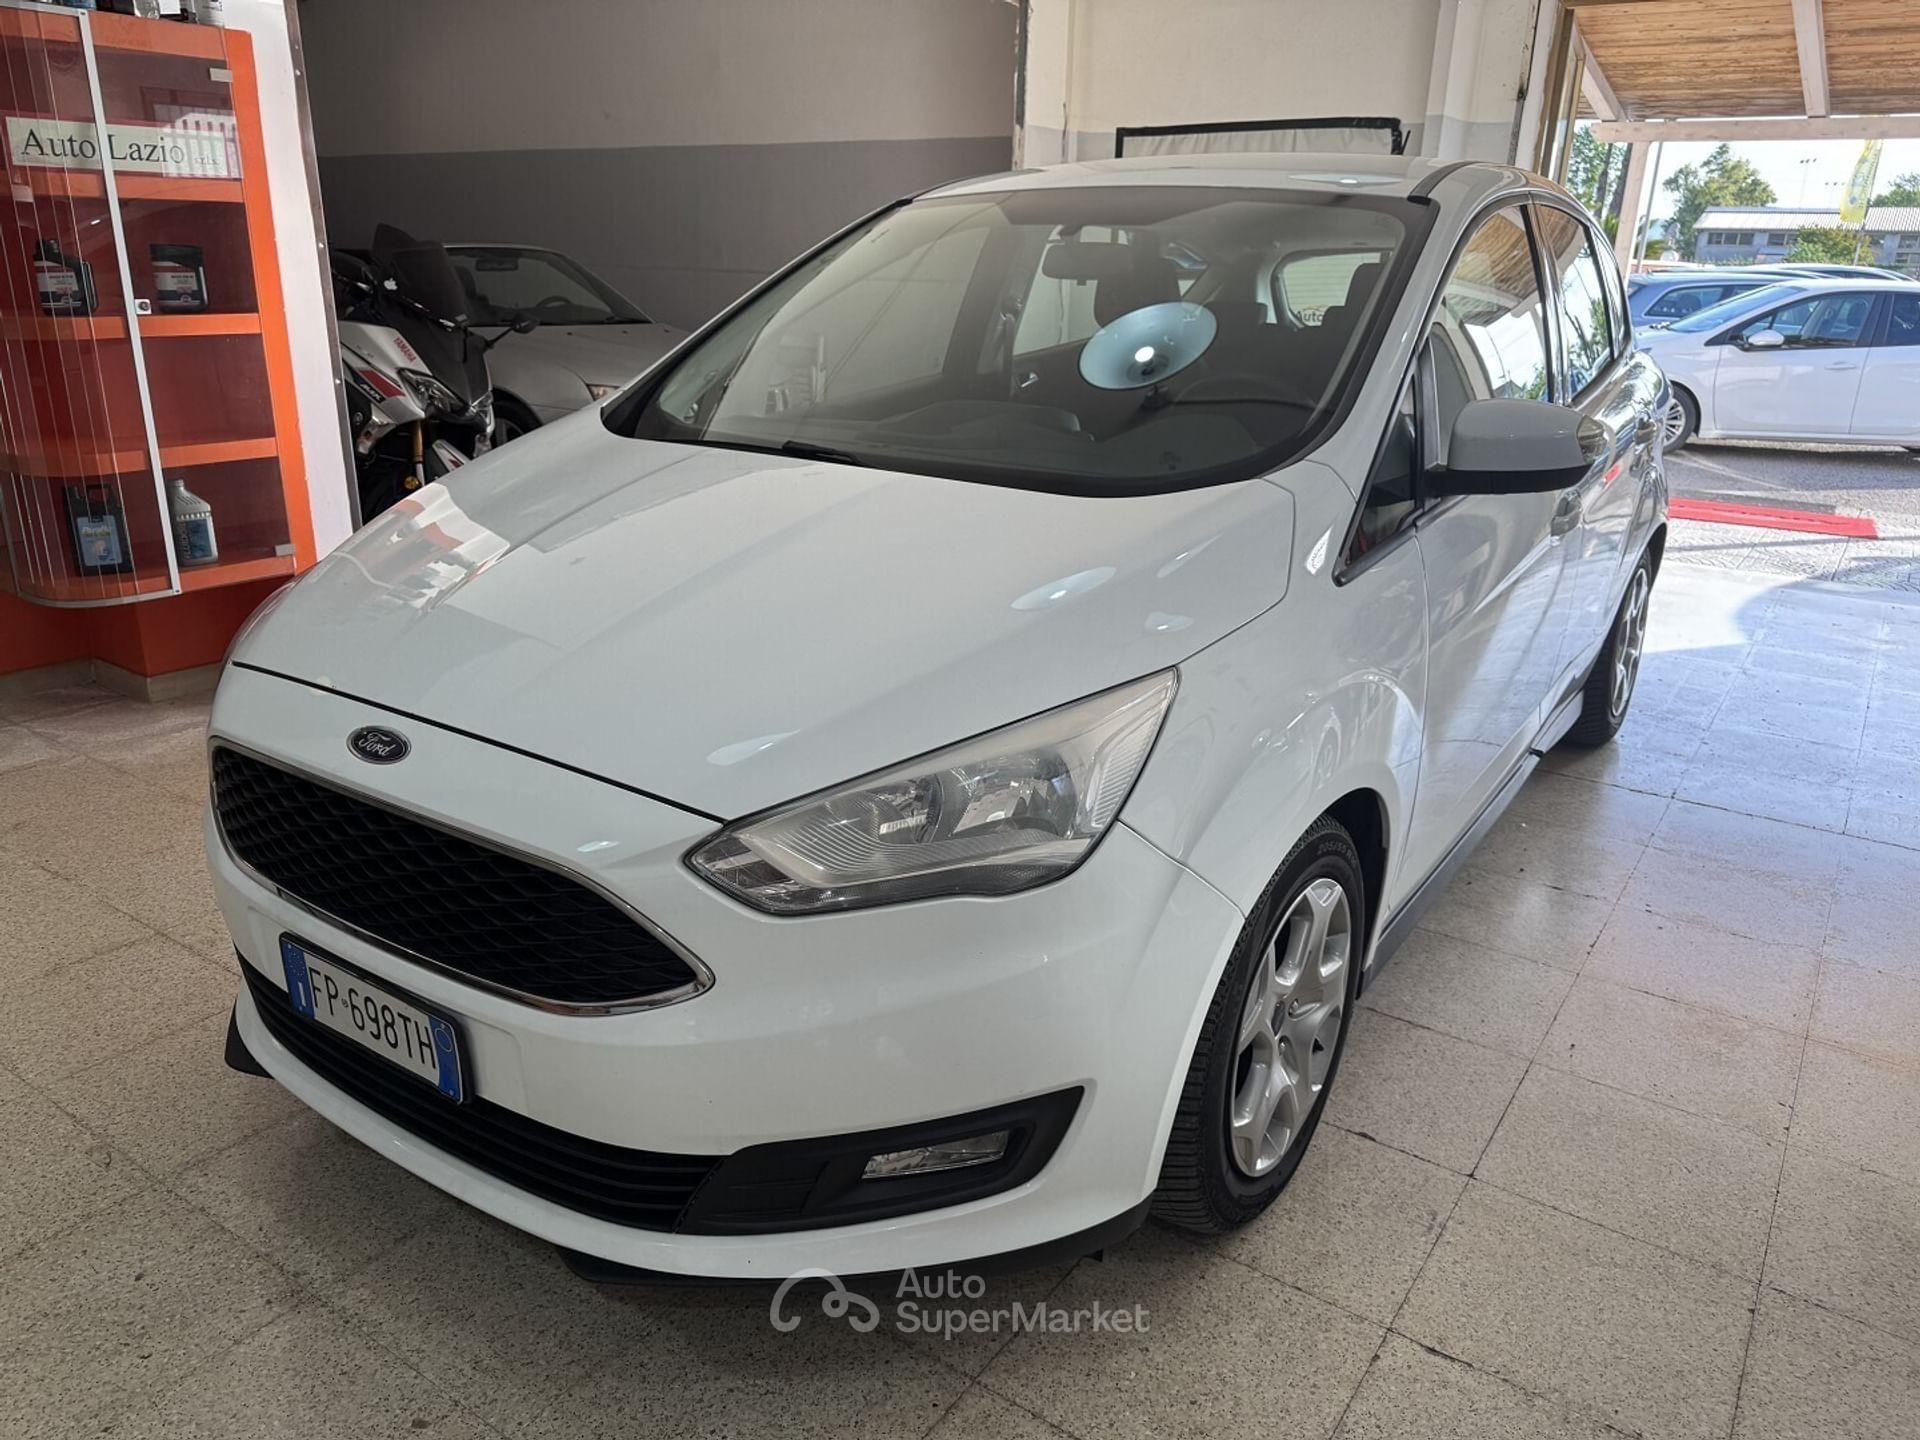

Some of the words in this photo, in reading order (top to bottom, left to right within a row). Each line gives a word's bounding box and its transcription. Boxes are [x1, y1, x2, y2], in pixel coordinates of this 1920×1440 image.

[20, 128, 97, 160] Auto
[107, 134, 185, 164] Lazio
[393, 336, 417, 362] YAMAHA
[358, 731, 397, 756] Ford
